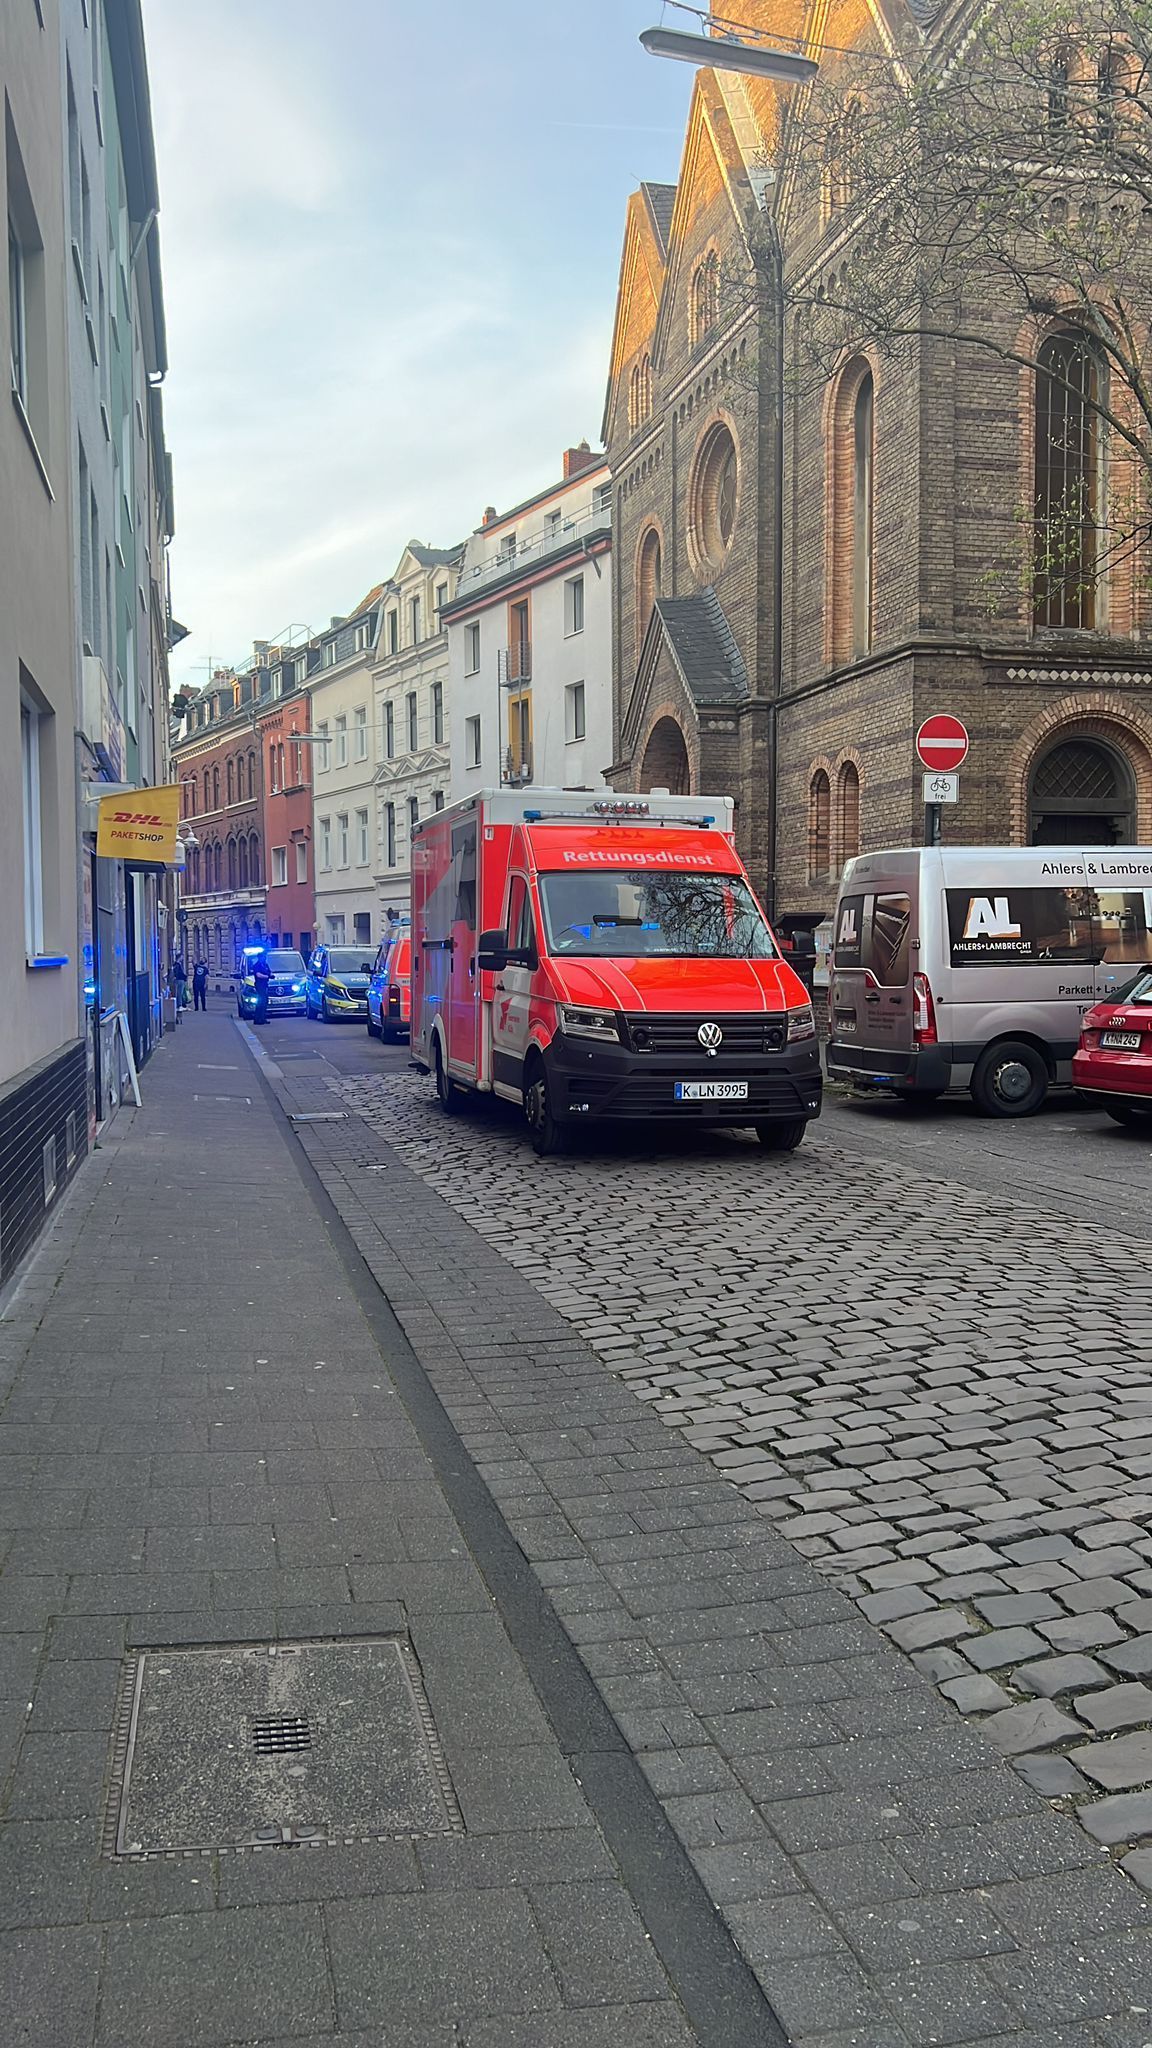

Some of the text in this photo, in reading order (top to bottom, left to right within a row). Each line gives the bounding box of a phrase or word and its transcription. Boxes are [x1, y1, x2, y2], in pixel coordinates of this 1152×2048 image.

[934, 792, 947, 800] frei
[113, 812, 163, 827] DHL
[110, 830, 164, 842] PAKETSHOP
[562, 851, 715, 865] Rettungsdienst
[1041, 863, 1084, 874] Ahlers
[1087, 863, 1098, 874] &
[962, 897, 1021, 939] AL
[952, 941, 1032, 951] AHLERS+LAMBRECHT
[1058, 985, 1093, 995] Parkett
[1104, 985, 1120, 994] La
[1076, 1005, 1091, 1015] Te
[1123, 1034, 1138, 1046] 245
[683, 1084, 746, 1097] K LN 3995
